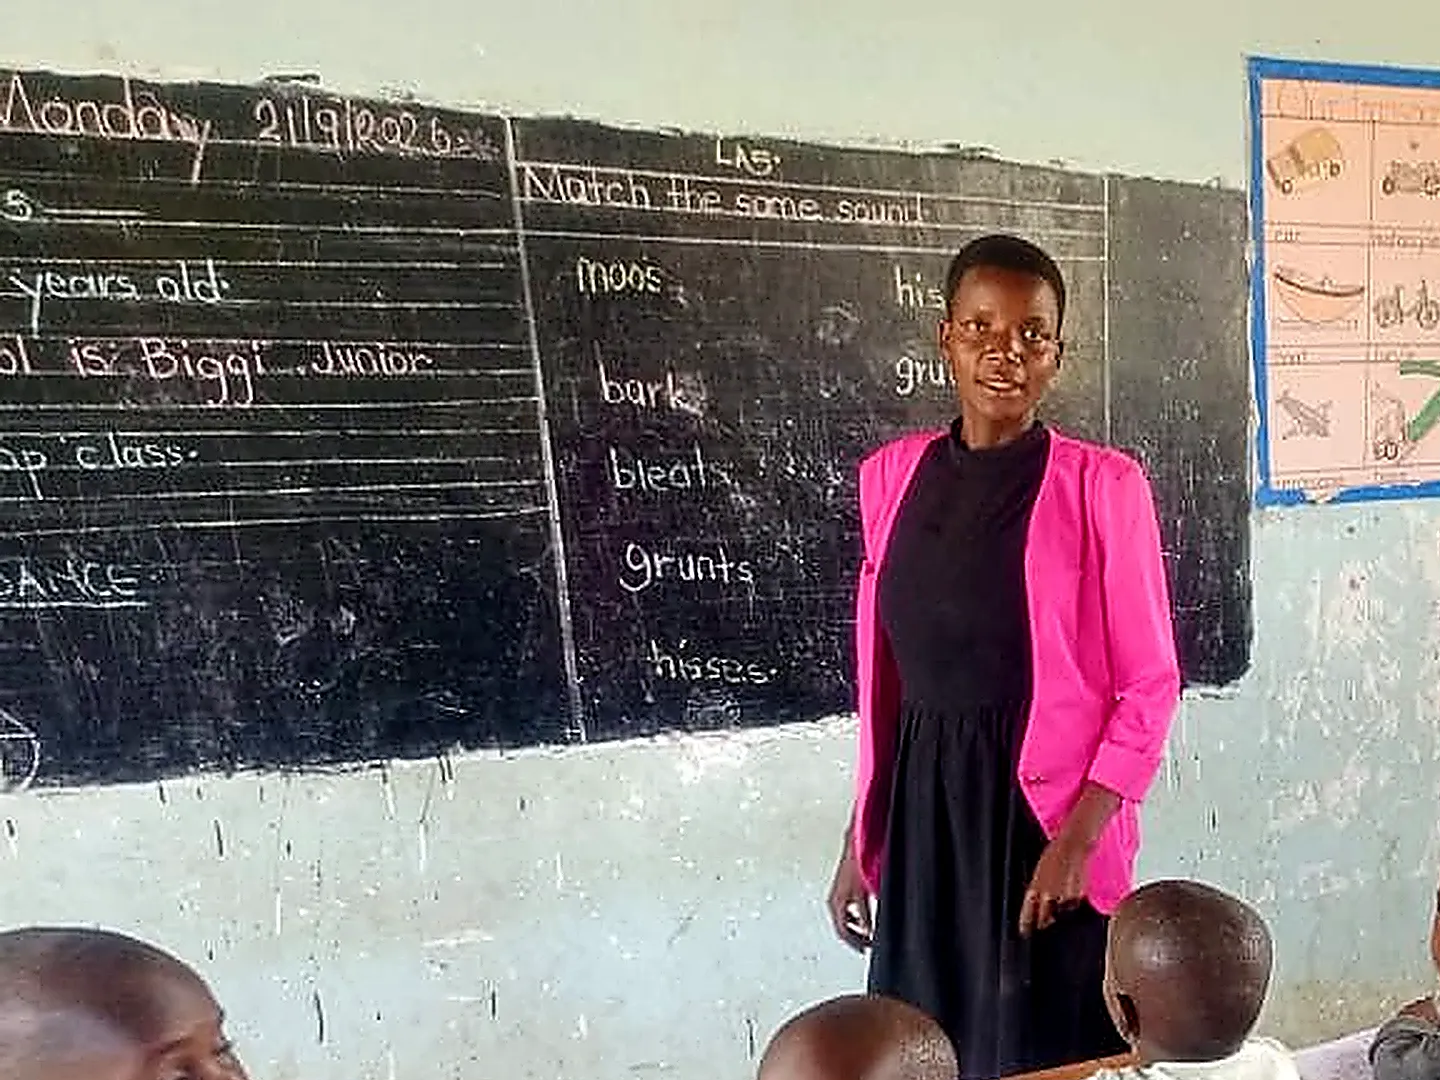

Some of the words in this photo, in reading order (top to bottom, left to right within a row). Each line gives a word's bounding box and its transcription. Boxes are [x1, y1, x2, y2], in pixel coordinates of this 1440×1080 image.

[9, 268, 141, 338] years
[895, 266, 947, 309] his
[896, 355, 957, 396] gru
[619, 543, 754, 592] grunts
